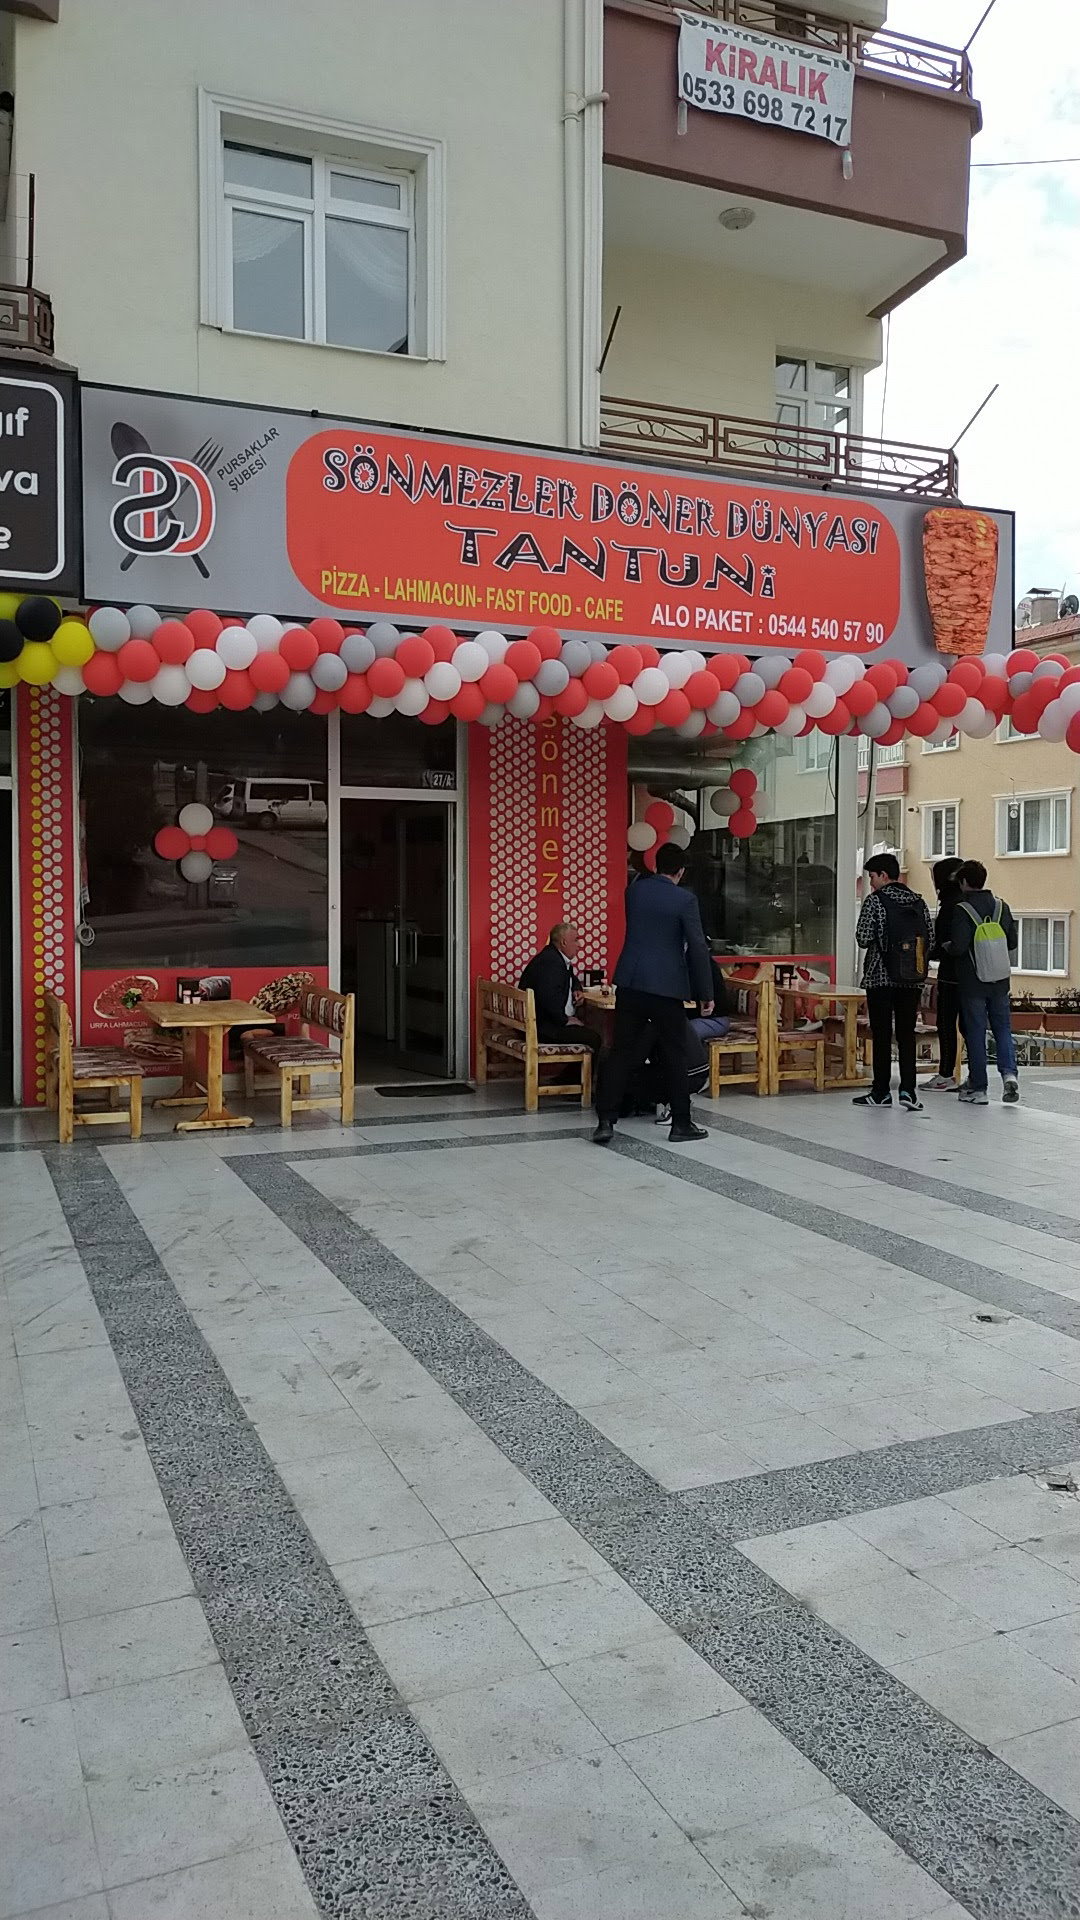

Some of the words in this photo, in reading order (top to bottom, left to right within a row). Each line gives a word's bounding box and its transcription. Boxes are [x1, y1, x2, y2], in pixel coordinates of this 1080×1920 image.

[682, 72, 736, 110] 0533
[743, 90, 784, 123] 698
[791, 102, 816, 131] 72
[822, 113, 848, 142] 17
[216, 427, 280, 480] PURSAKLAR
[228, 453, 268, 493] ŞUBESİ
[322, 444, 584, 521] SÖNMEZLER
[590, 481, 720, 538] DÖNER
[726, 499, 881, 555] DÜNYASI
[321, 565, 371, 598] PİZZA
[486, 586, 525, 612] FAST
[529, 591, 572, 617] FOOD
[584, 596, 624, 622] CAFE
[650, 603, 690, 628] ALO
[694, 607, 753, 633] PAKET
[768, 613, 807, 638] 0544
[811, 618, 839, 641] 540
[843, 621, 861, 642] 57
[866, 623, 884, 644] 90
